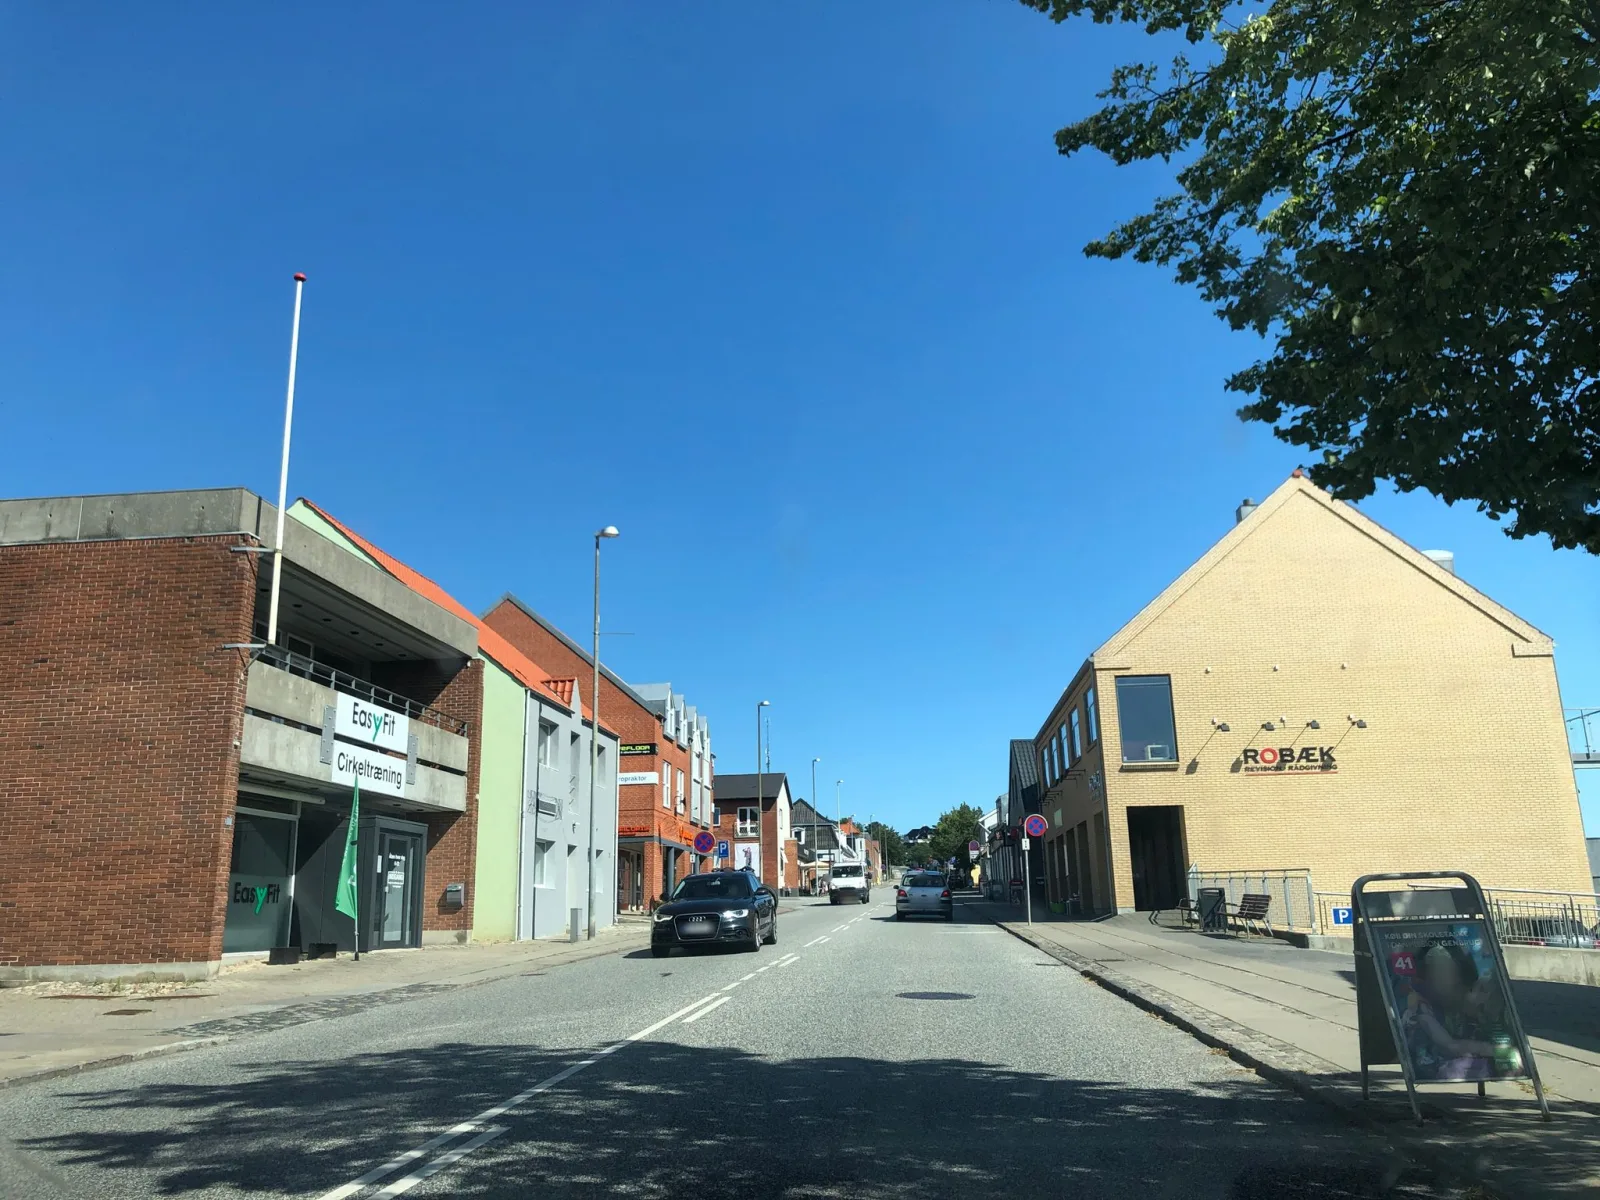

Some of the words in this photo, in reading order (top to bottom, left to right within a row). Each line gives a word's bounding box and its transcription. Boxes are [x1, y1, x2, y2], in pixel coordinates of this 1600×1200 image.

[352, 702, 396, 742] EasyFit
[1243, 746, 1336, 764] ROBÆK
[337, 752, 402, 789] Cirkeltræning
[719, 843, 727, 853] P
[233, 881, 281, 914] EasyFit
[1338, 909, 1349, 923] P
[1395, 956, 1414, 970] 41
